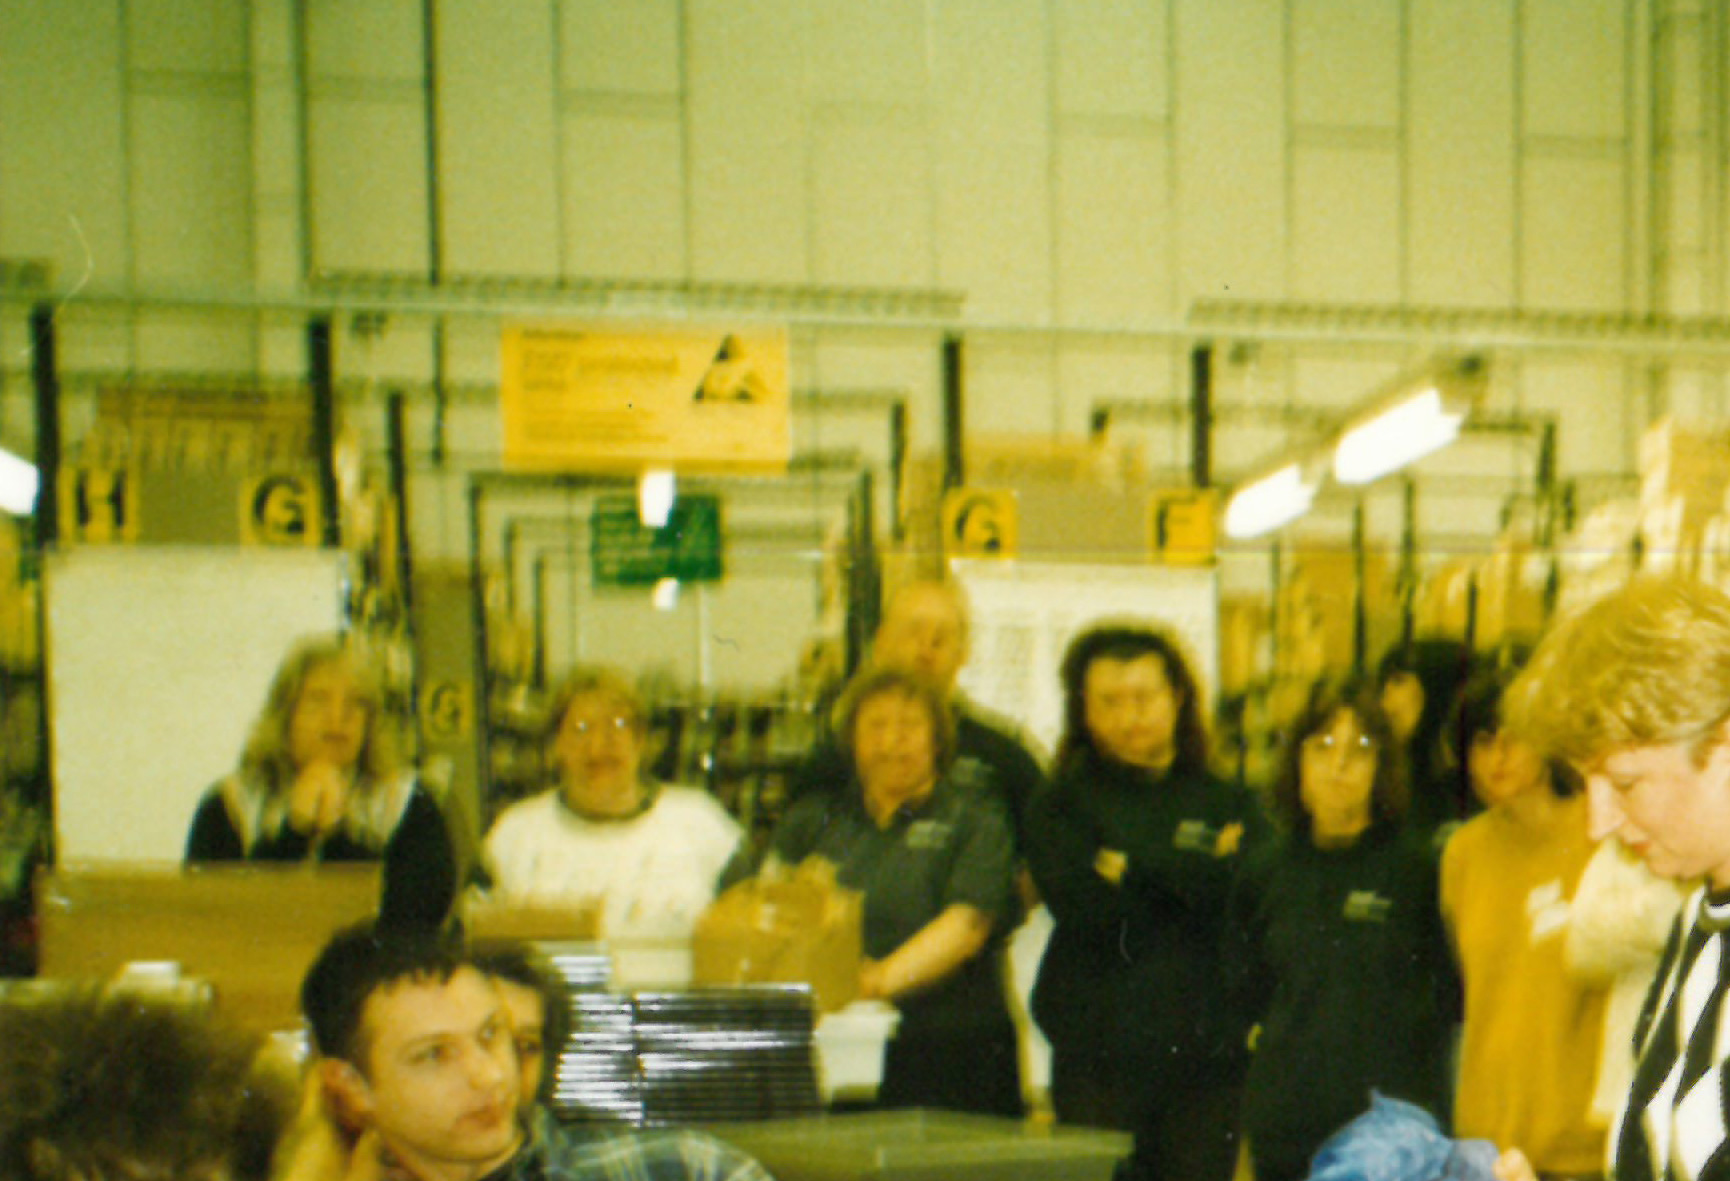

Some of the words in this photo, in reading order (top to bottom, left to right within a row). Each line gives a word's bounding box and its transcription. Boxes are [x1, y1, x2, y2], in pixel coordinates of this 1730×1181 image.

[75, 469, 126, 532] H
[253, 474, 307, 543] G
[954, 495, 1001, 553] G
